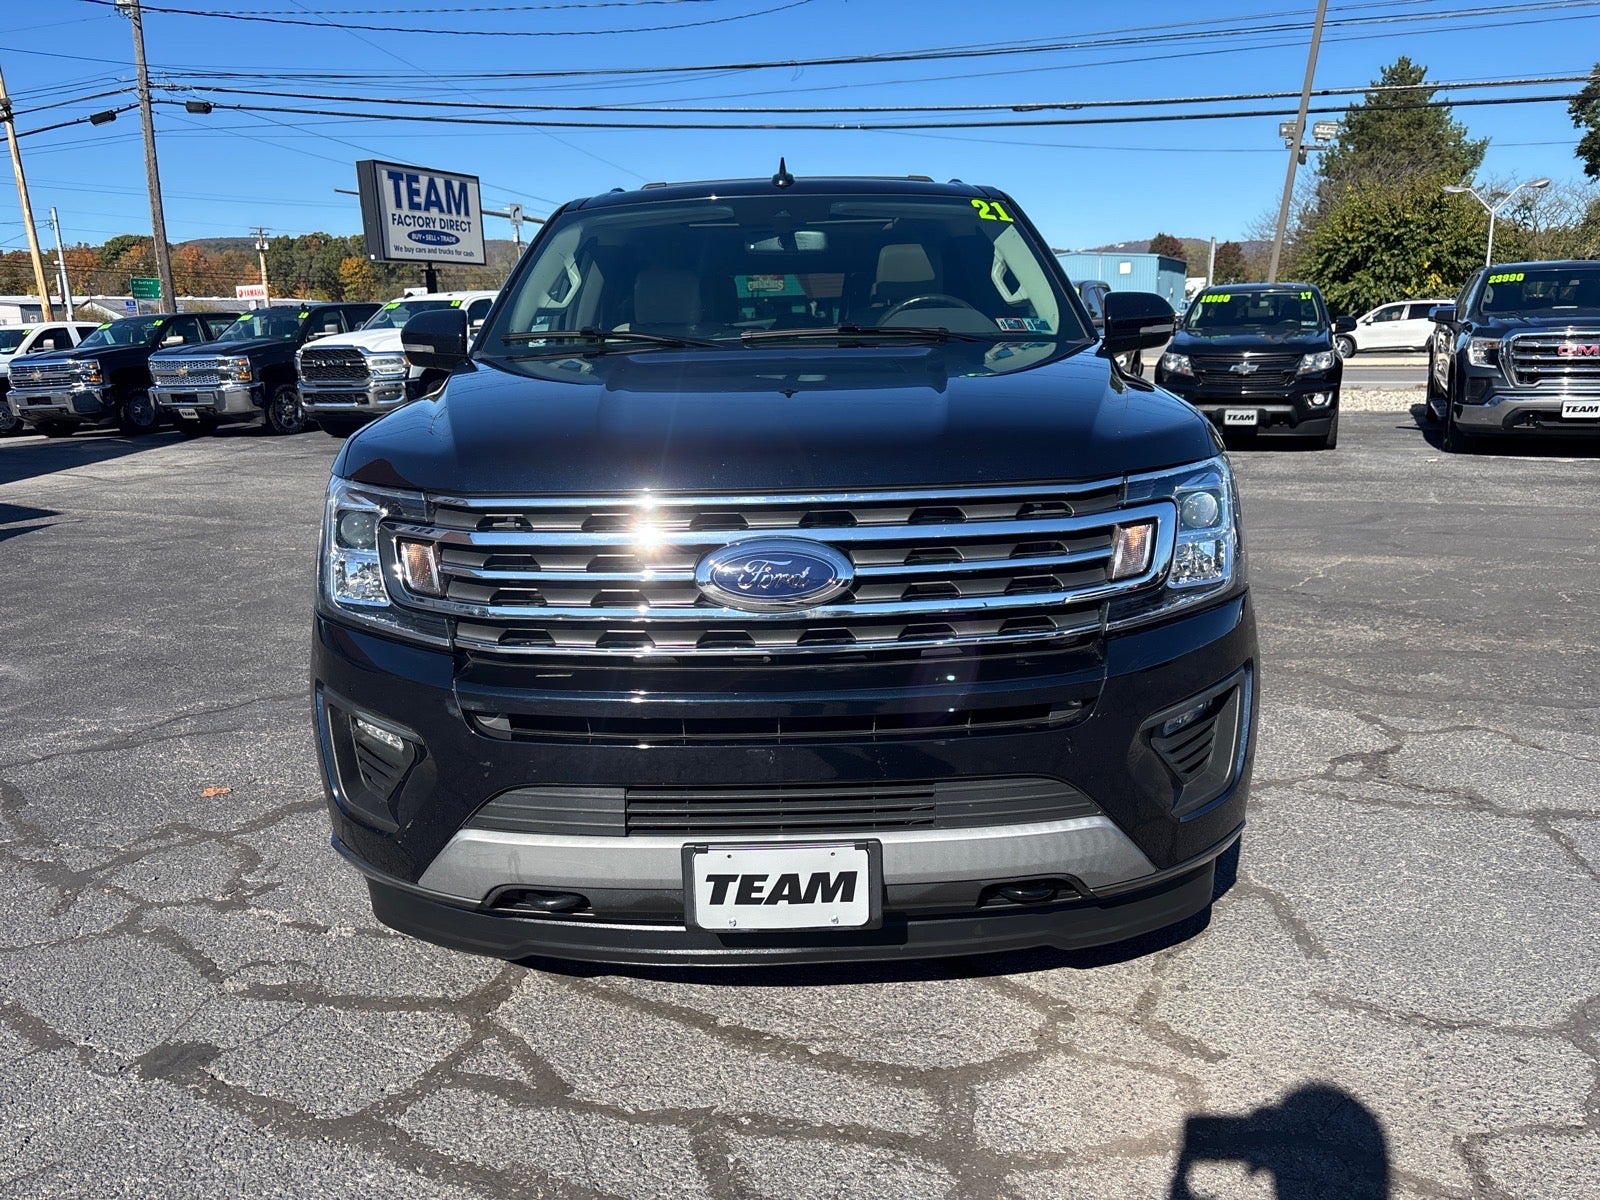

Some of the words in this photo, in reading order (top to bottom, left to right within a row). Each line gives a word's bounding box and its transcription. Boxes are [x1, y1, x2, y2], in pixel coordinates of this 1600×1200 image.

[387, 171, 470, 217] TEAM
[971, 199, 1014, 222] 21
[391, 213, 437, 229] FACTORY
[440, 218, 471, 232] DIRECT
[440, 235, 457, 243] TRADE
[404, 245, 414, 255] buy
[438, 247, 454, 255] trucks
[463, 249, 475, 257] cash
[243, 289, 264, 297] YAMAHA
[1557, 344, 1600, 356] GM
[1565, 405, 1599, 413] TEAM
[737, 558, 812, 590] Ford
[705, 870, 858, 905] TEAM
